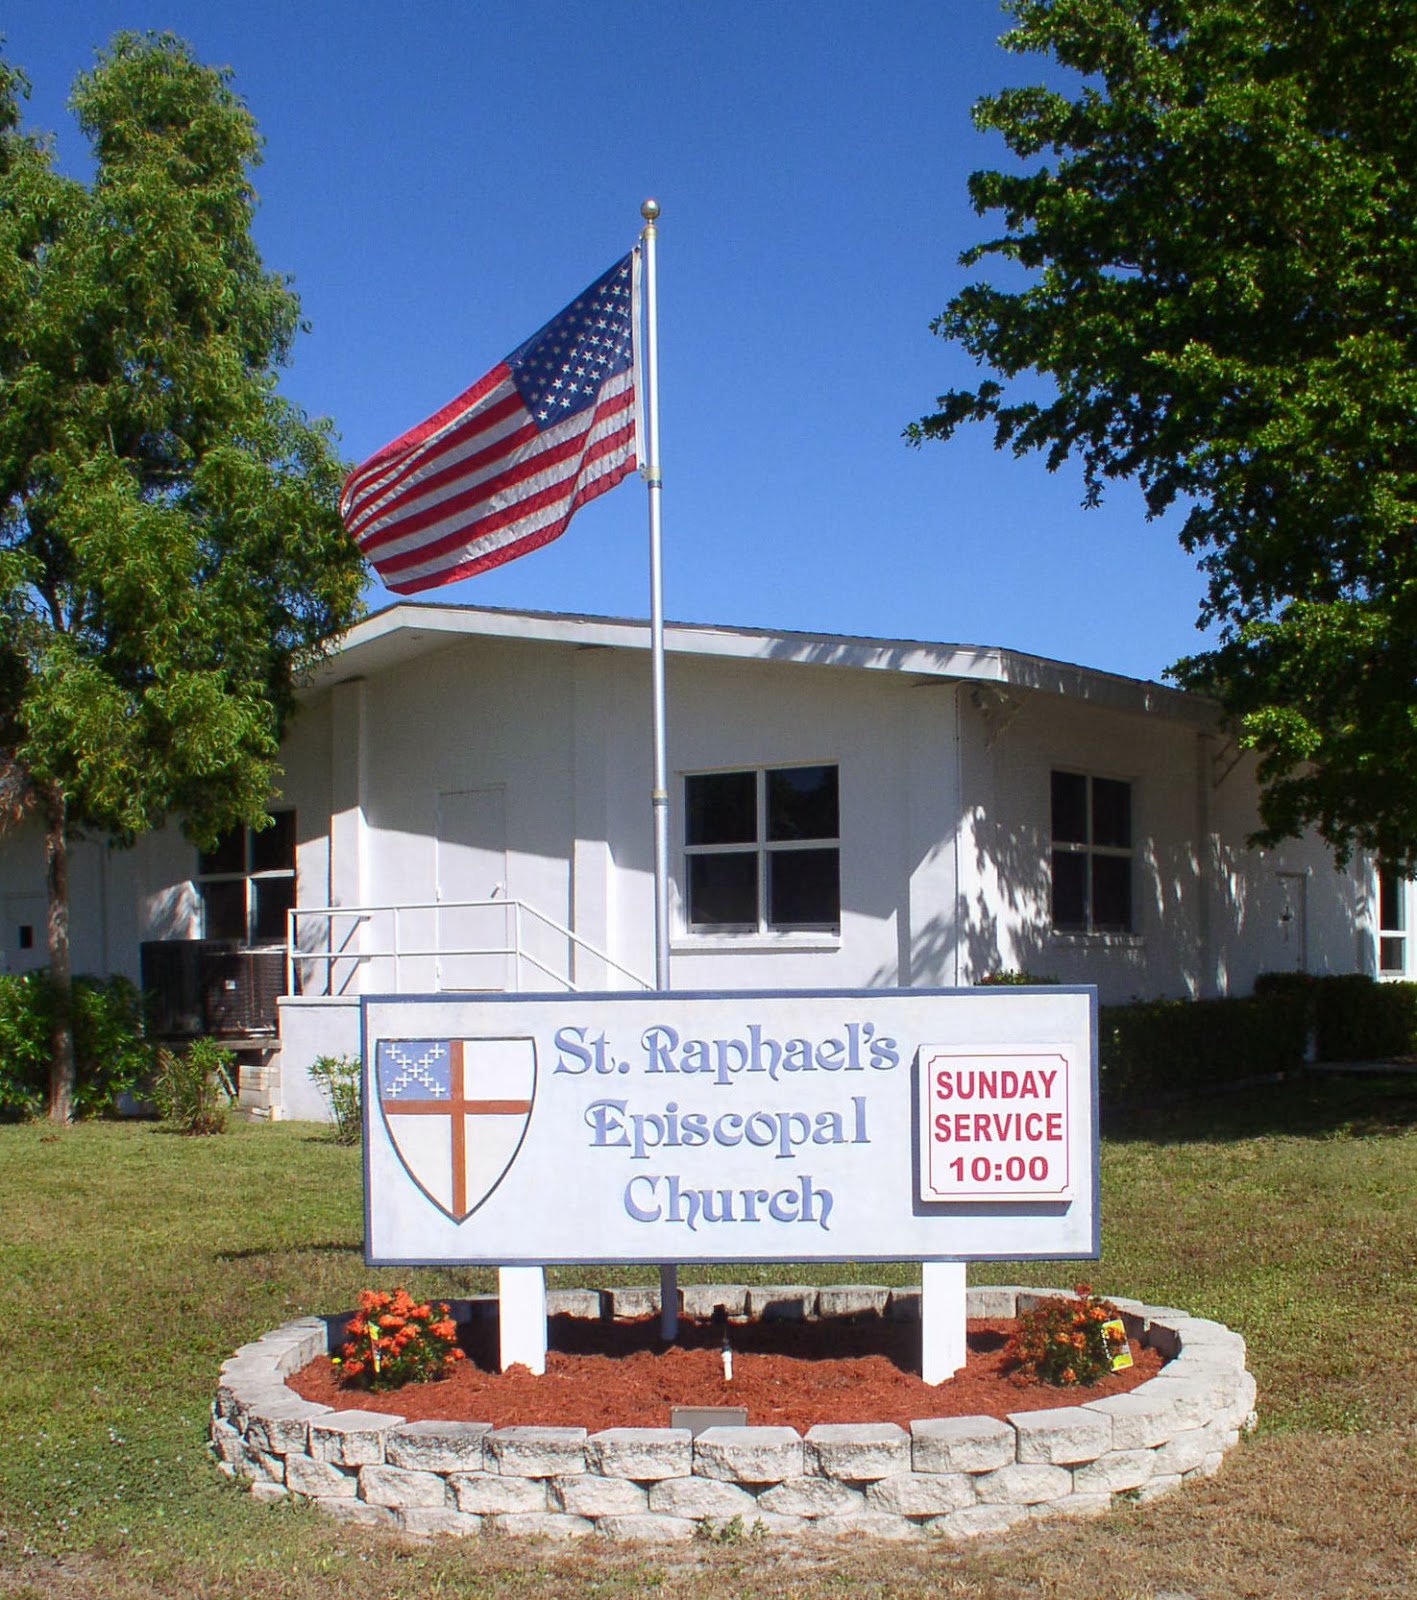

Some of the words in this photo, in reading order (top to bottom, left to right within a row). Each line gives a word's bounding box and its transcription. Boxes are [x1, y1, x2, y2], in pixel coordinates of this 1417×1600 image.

[553, 1026, 630, 1075] St.
[641, 1022, 900, 1086] Raphael's
[936, 1070, 1058, 1100] SUNDAY
[585, 1096, 872, 1158] Episcopal
[934, 1112, 1063, 1142] SERVICE
[949, 1156, 1049, 1182] 10:00
[624, 1175, 834, 1231] Church
